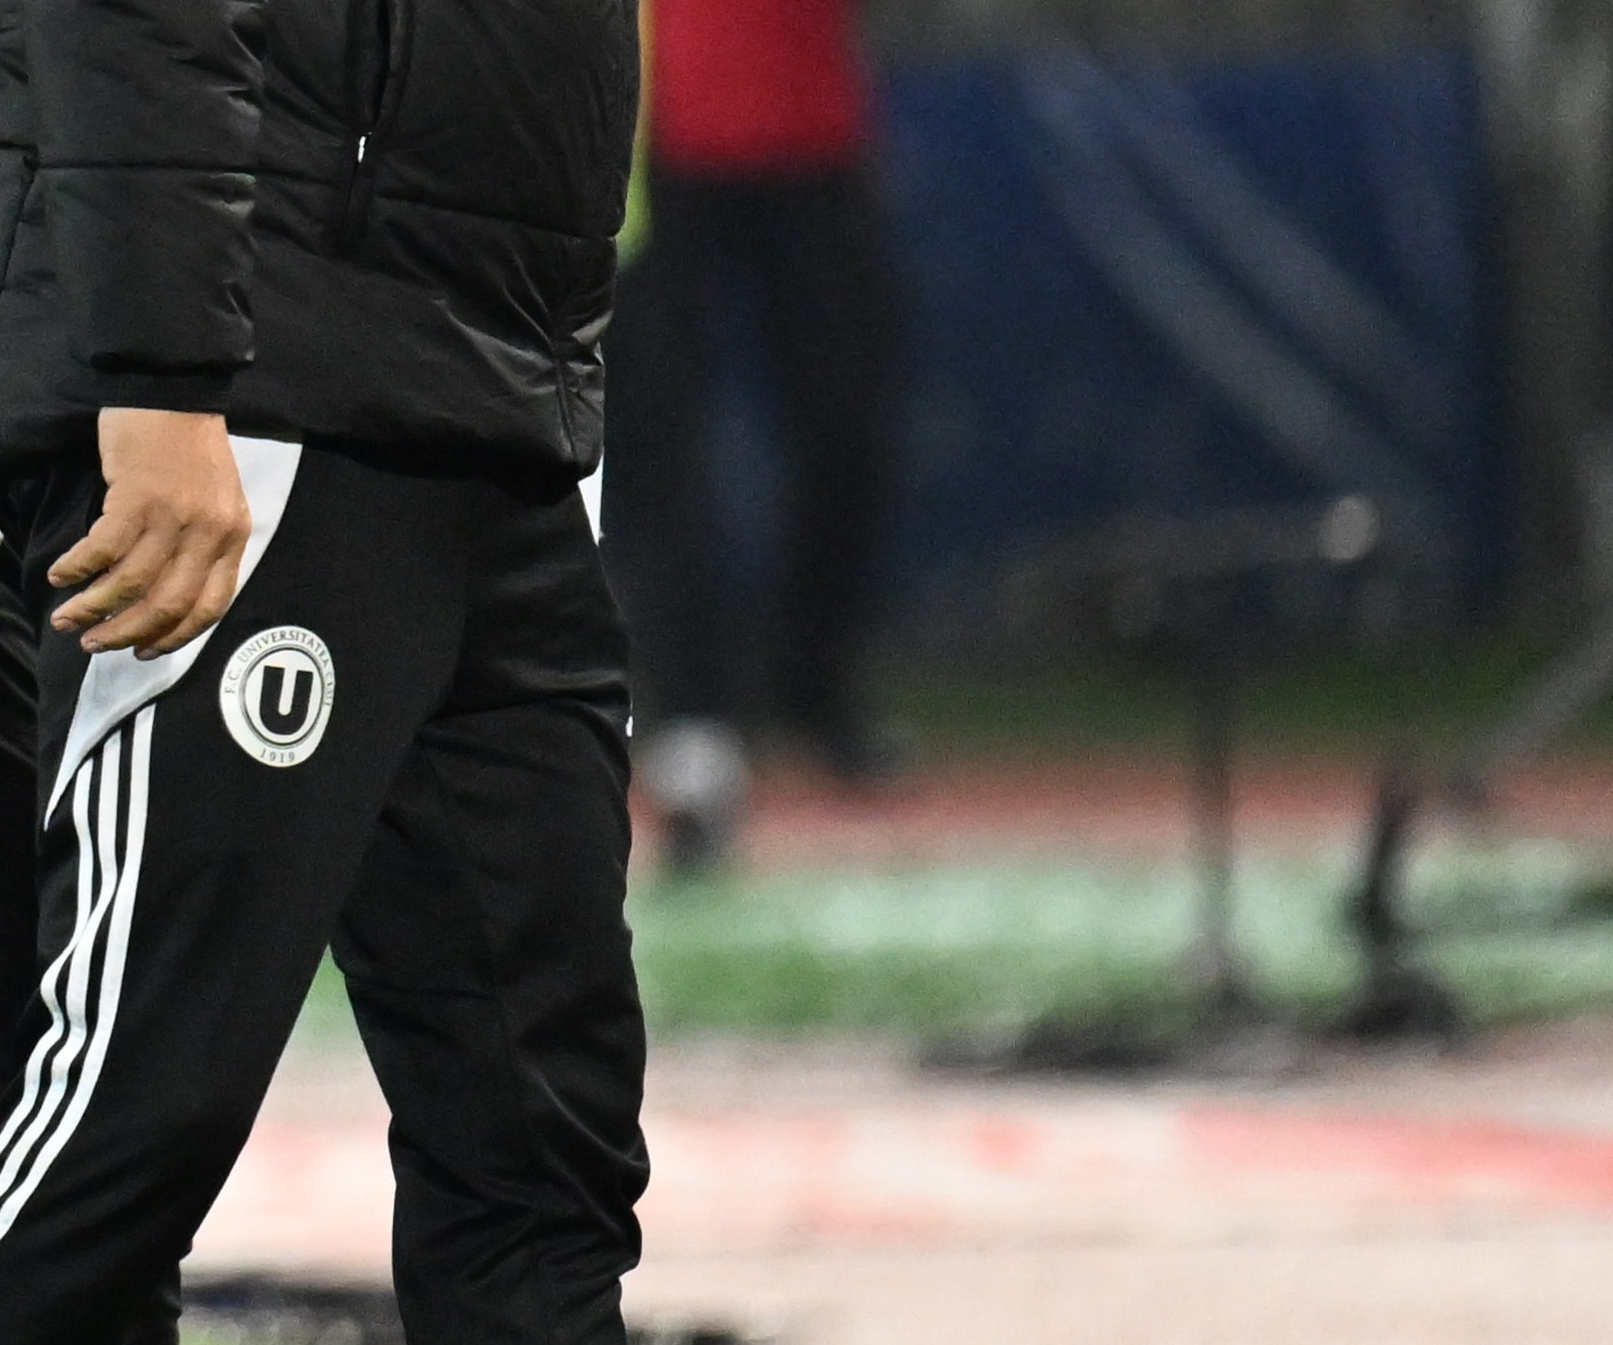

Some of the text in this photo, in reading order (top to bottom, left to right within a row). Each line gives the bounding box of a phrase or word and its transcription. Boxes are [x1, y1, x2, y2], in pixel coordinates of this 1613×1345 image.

[237, 630, 331, 668] UNIVERSITATEA
[259, 665, 314, 736] U
[260, 748, 296, 763] 1919
